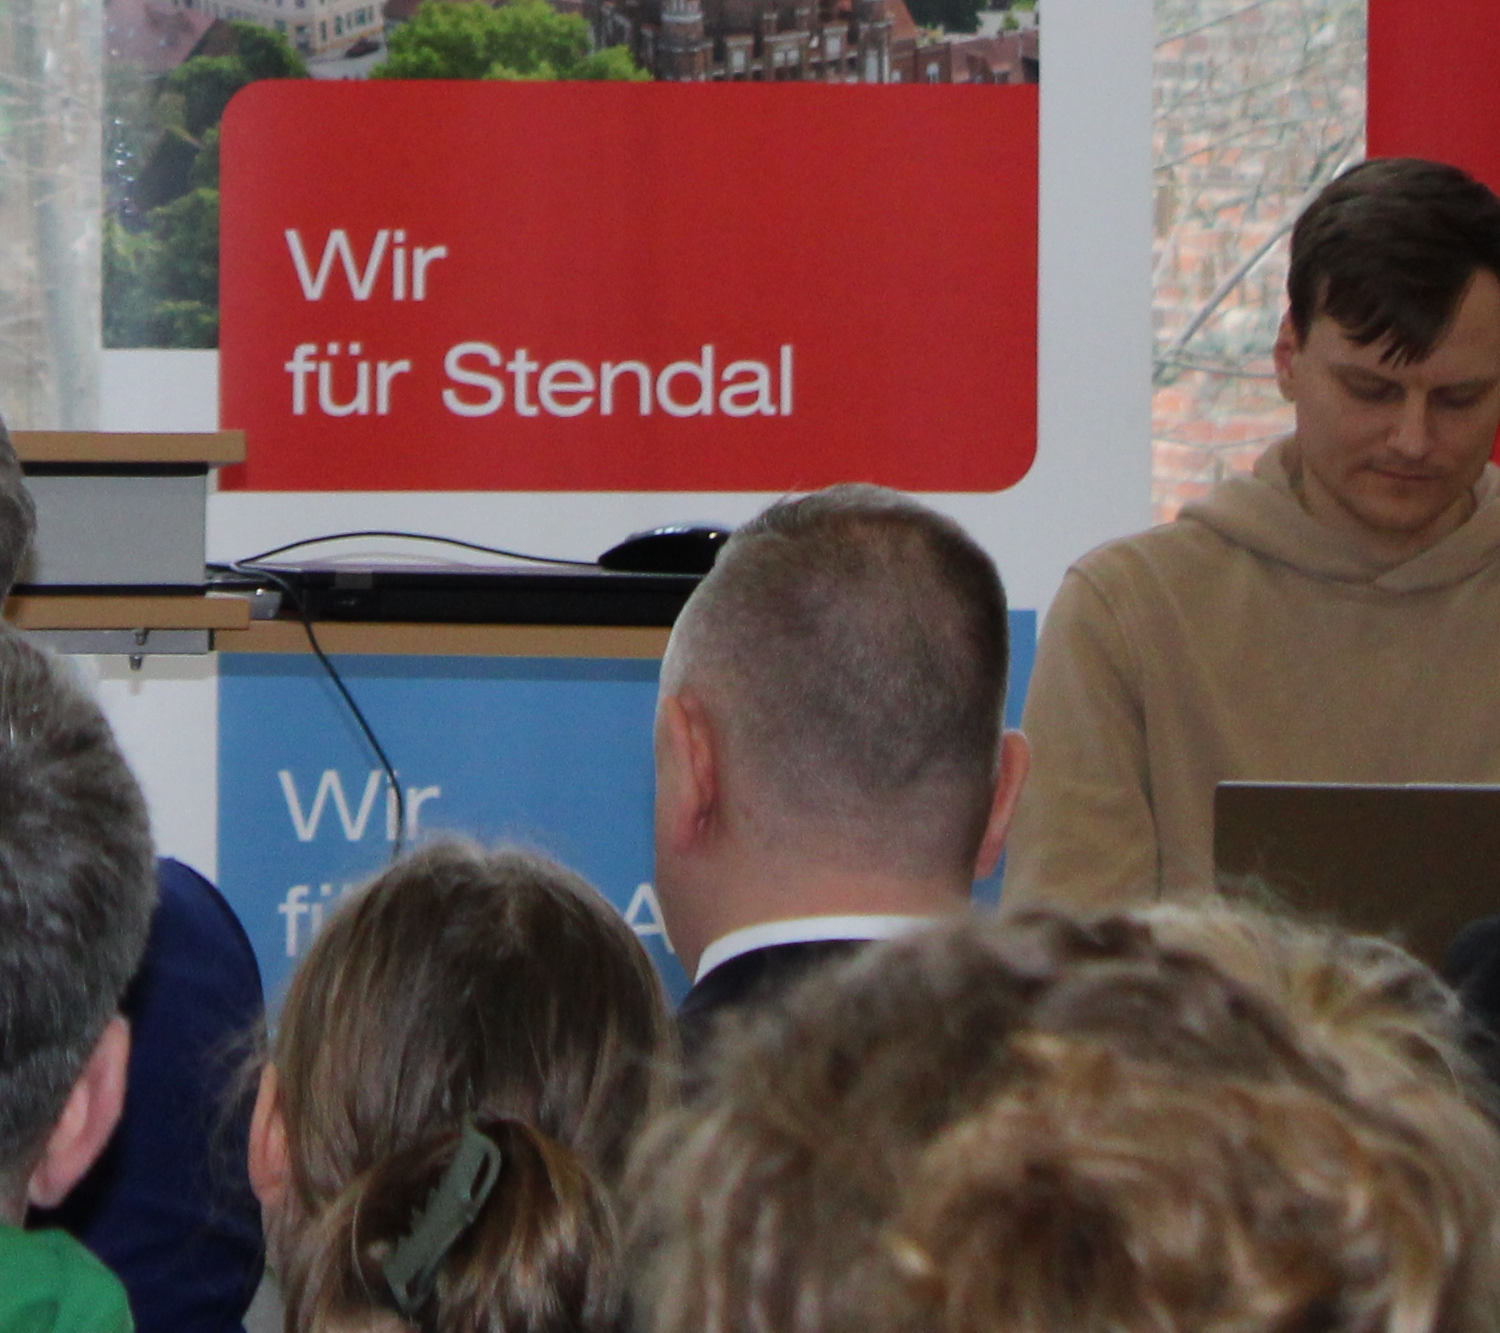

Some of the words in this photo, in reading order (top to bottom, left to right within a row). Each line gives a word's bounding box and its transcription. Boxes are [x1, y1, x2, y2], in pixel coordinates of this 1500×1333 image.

[285, 229, 448, 301] Wir
[284, 342, 412, 417] für
[442, 340, 795, 418] Stendal
[277, 769, 441, 842] Wir
